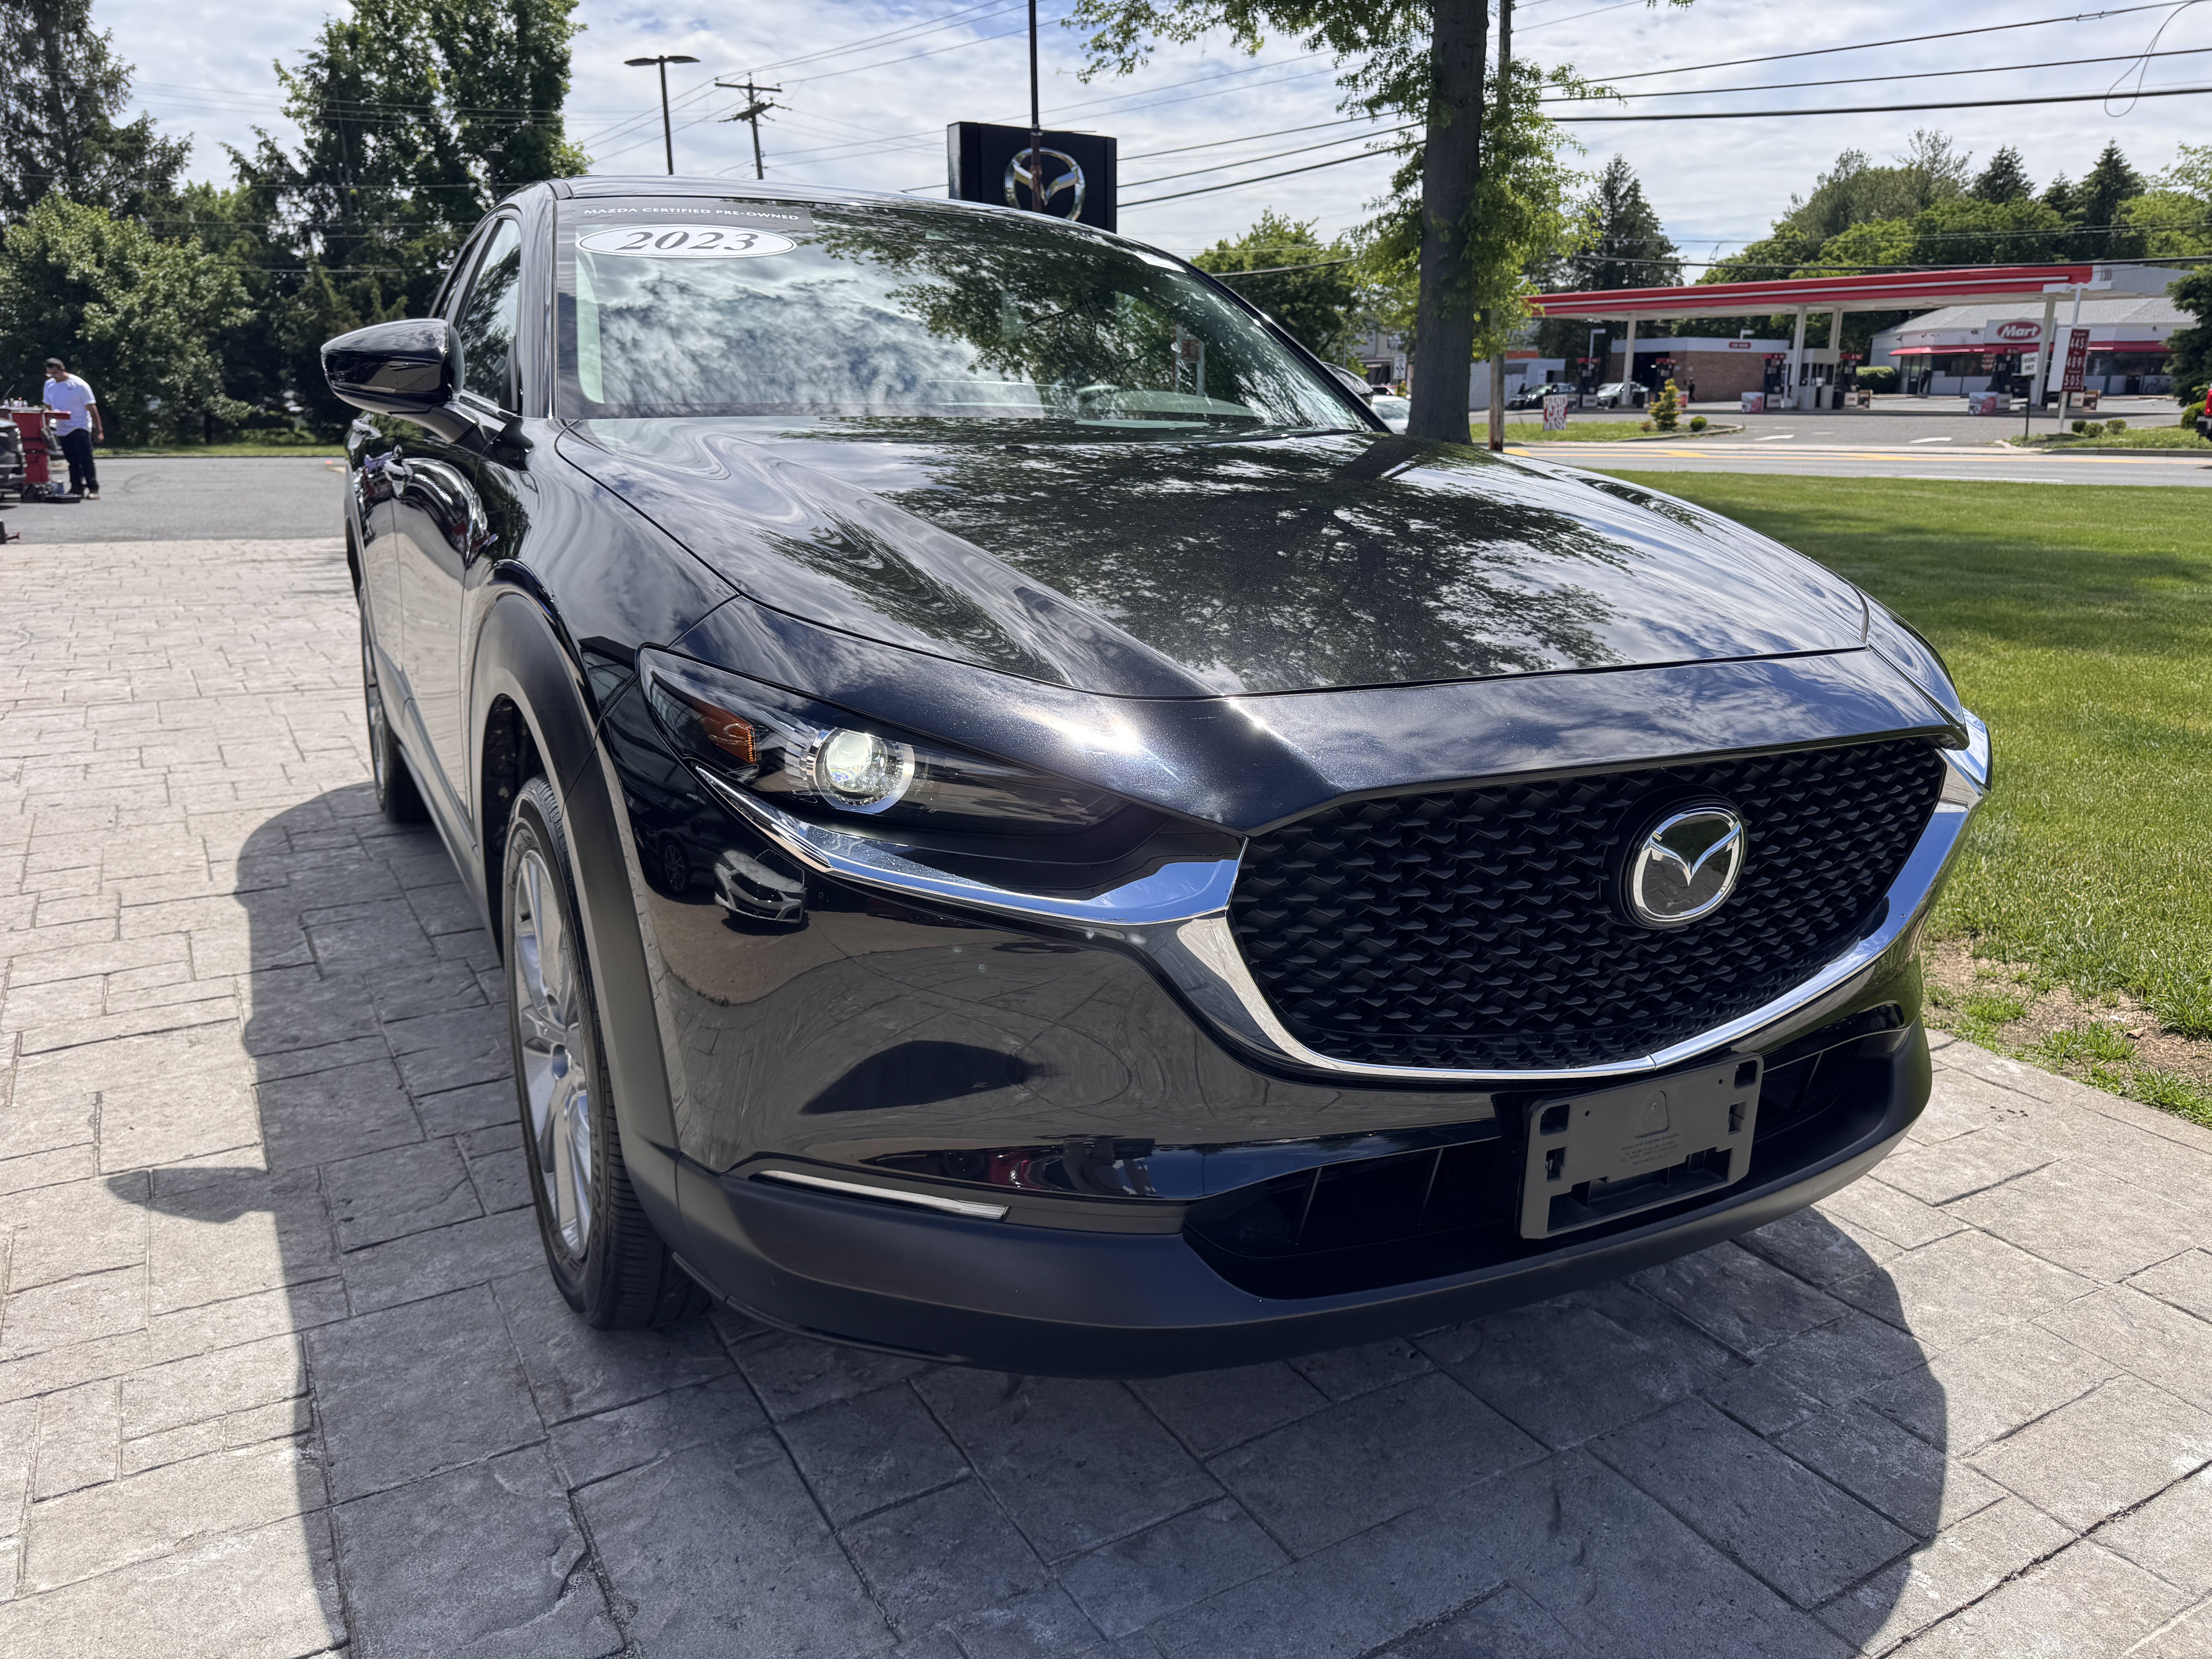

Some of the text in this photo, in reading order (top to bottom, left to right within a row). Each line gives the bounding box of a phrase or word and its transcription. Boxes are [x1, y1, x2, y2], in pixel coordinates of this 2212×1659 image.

[716, 210, 799, 220] PRE-OWNED
[615, 231, 759, 251] 2023
[2001, 325, 2038, 338] Mart
[2070, 338, 2085, 349] 445
[2064, 374, 2080, 386] 505
[1543, 395, 1568, 408] HAND
[1546, 404, 1565, 421] CAR
